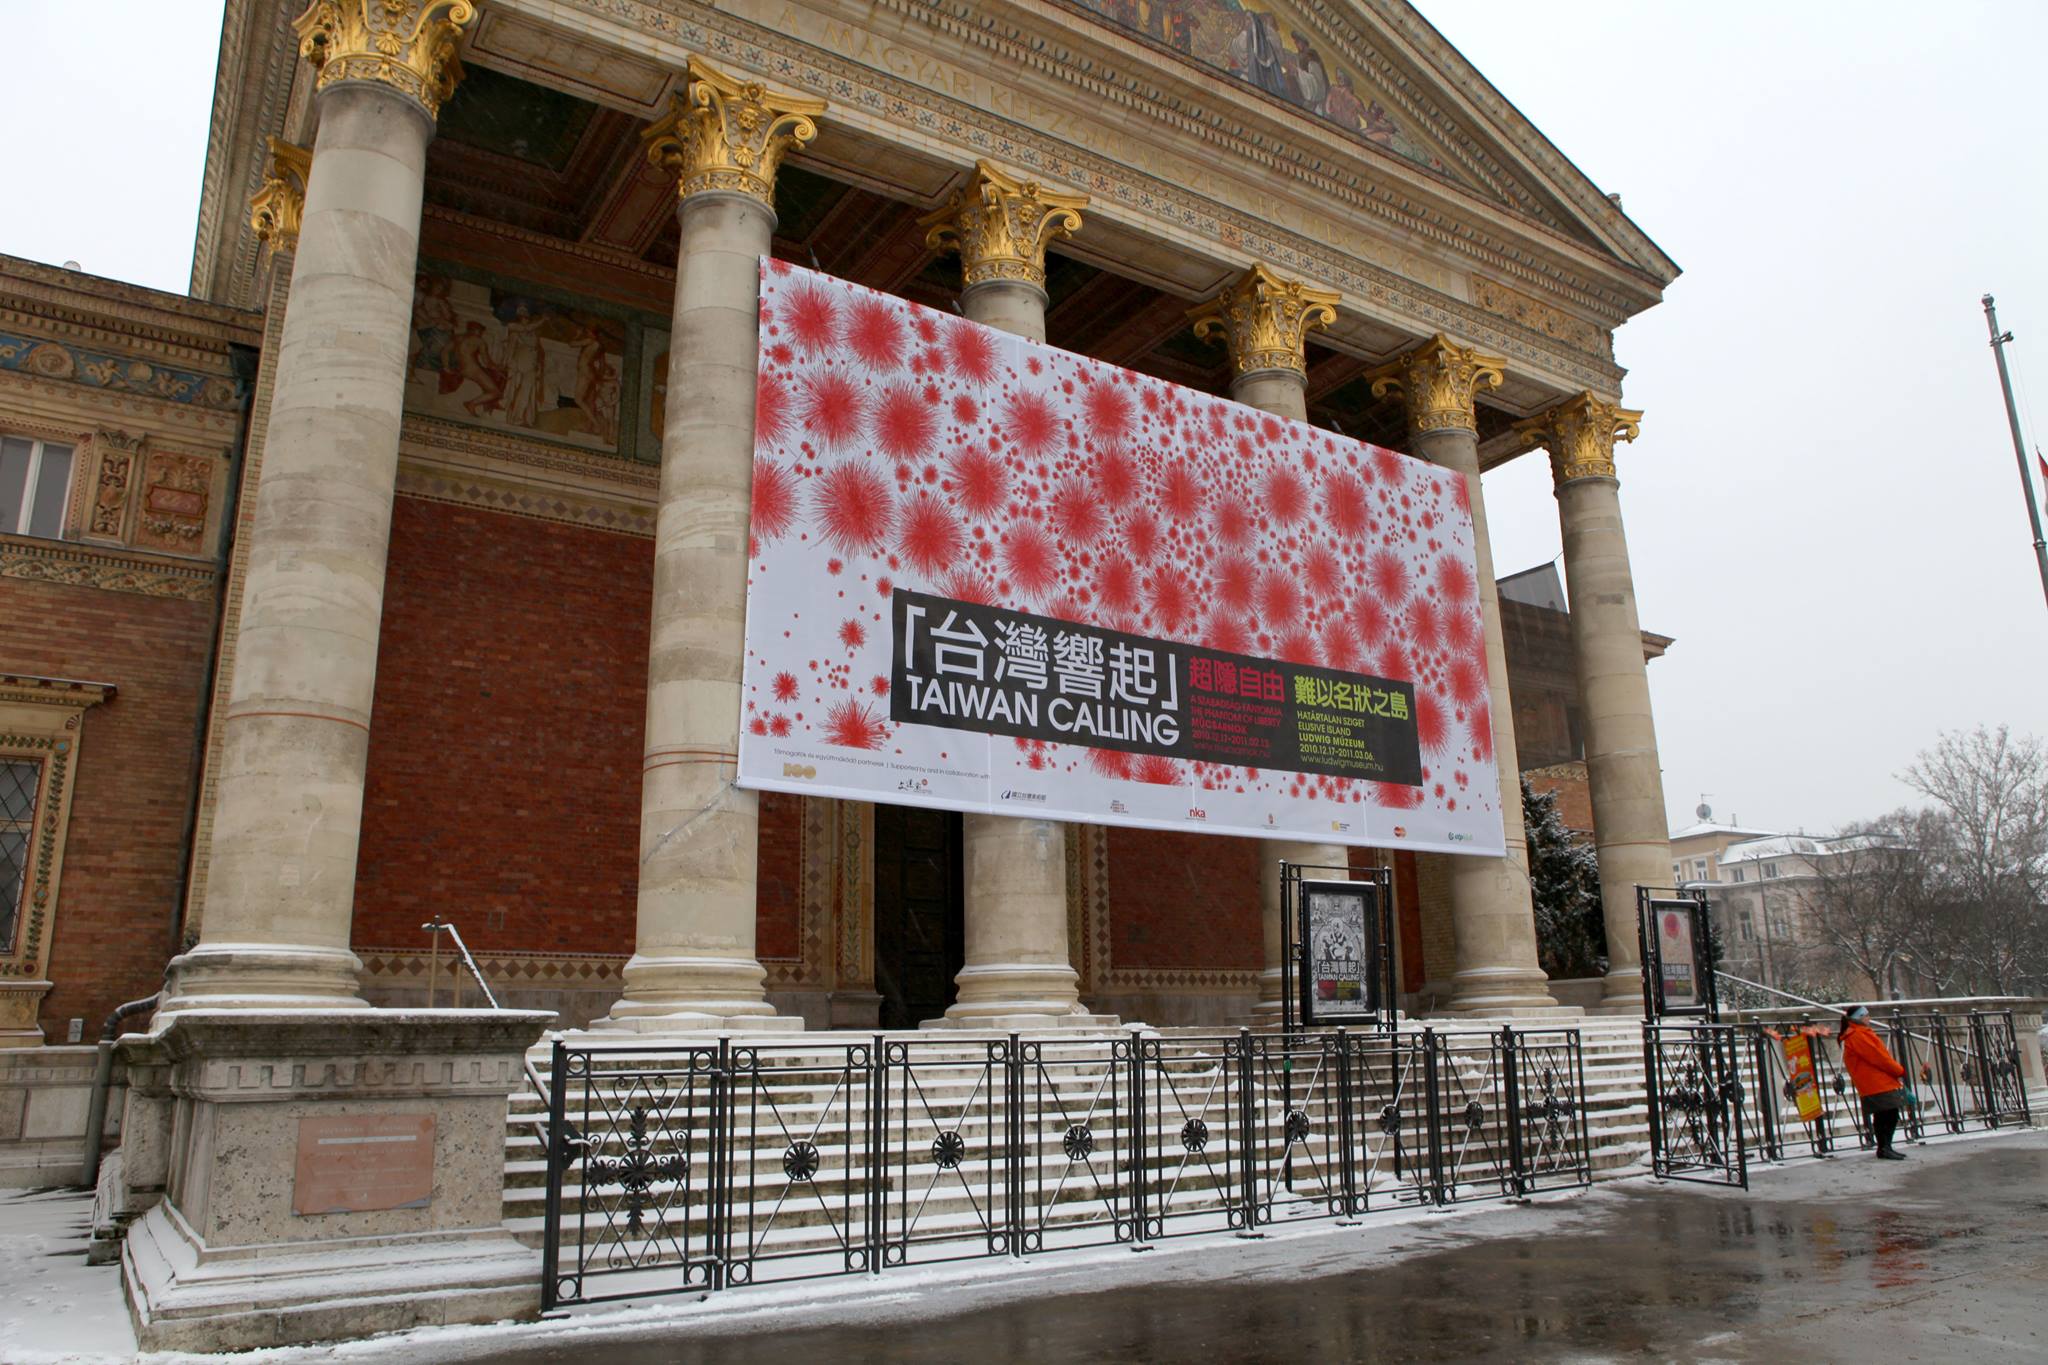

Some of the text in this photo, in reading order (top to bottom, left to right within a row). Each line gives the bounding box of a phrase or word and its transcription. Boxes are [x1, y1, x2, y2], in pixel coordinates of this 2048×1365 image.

[777, 2, 799, 35] A
[820, 18, 969, 99] MAGYAR
[1294, 675, 1409, 721] 難以名狀之島
[906, 675, 1180, 746] TAIWAN CALLING
[1297, 710, 1365, 728] HATÁRTALAN SZIGET
[1298, 722, 1351, 736] ELUSIVE ISLAND
[1299, 733, 1365, 749] LUDWIG MÚZEUM
[1301, 754, 1384, 771] www.ludwigmuseum.hu
[1189, 806, 1207, 818] nka
